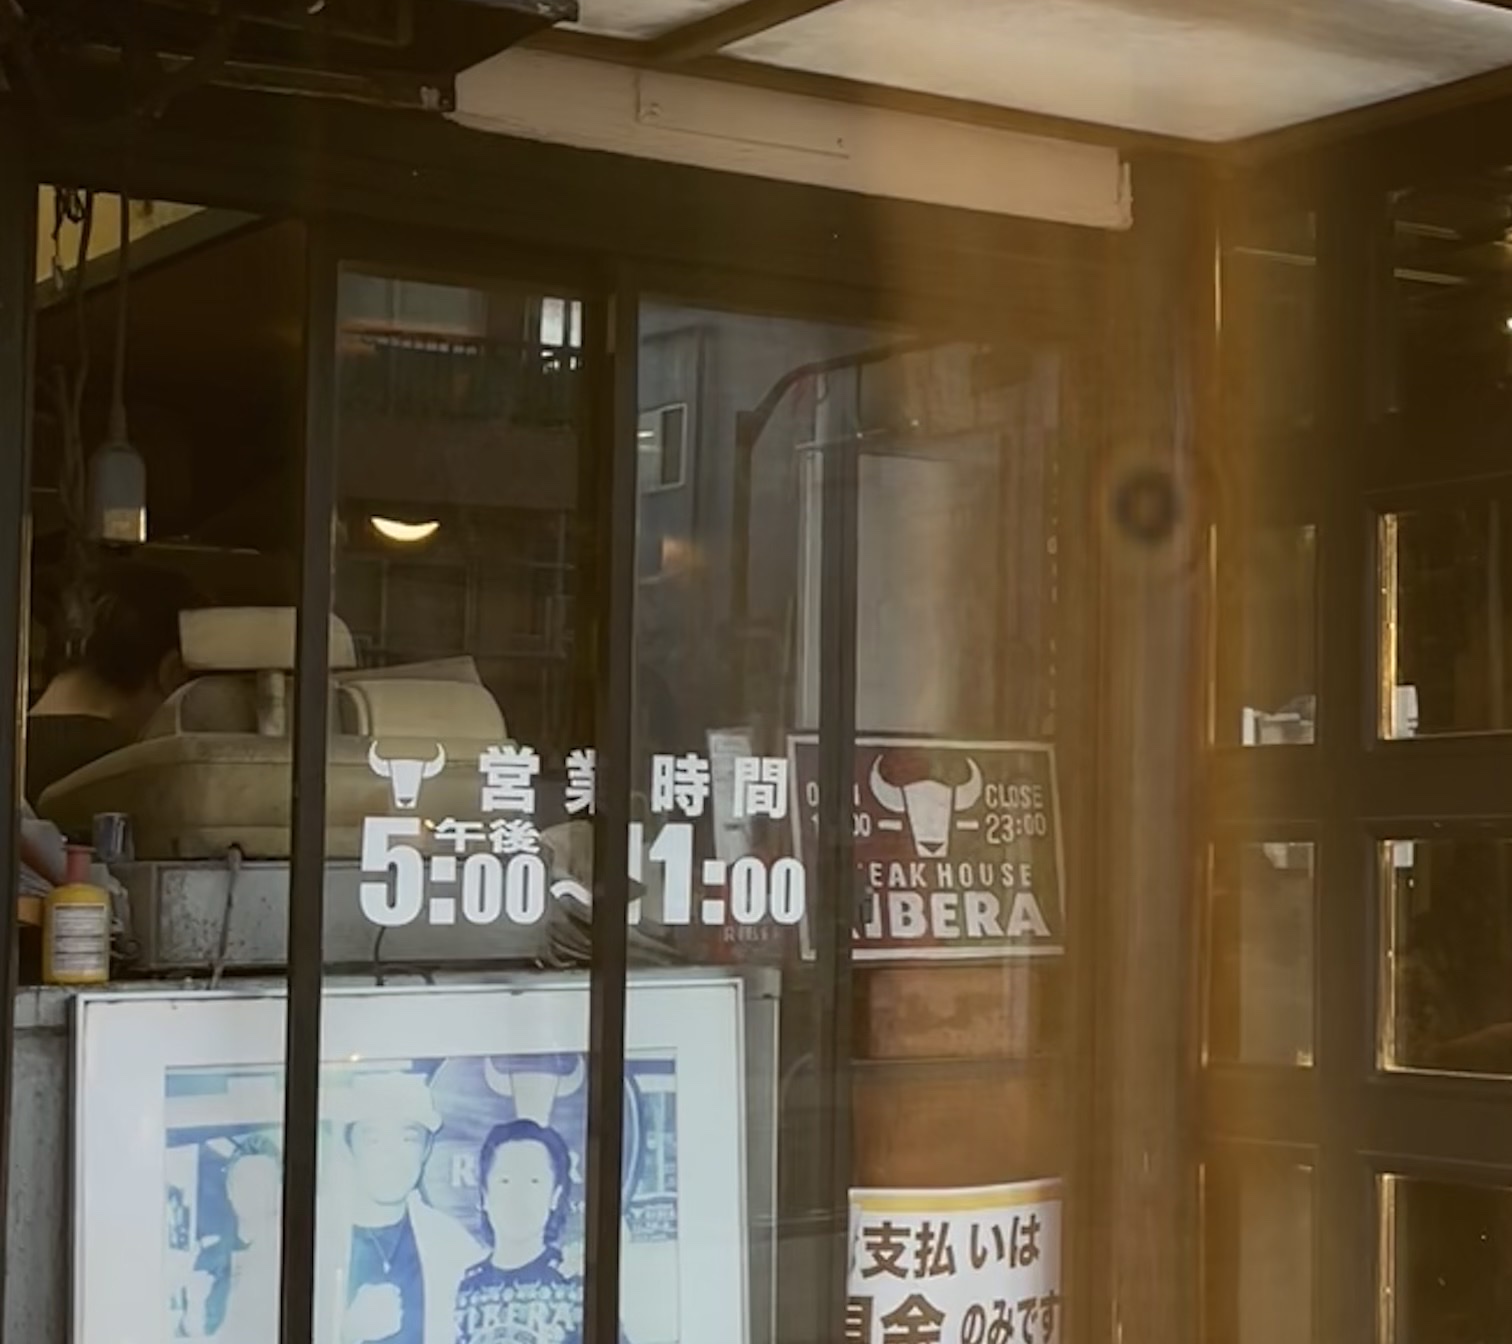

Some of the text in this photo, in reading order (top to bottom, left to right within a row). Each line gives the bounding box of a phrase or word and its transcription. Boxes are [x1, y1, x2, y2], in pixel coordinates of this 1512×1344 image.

[986, 783, 1044, 809] CLOSE
[434, 817, 541, 854] 午後
[985, 812, 1048, 844] 23:00
[857, 862, 1033, 888] EAK HOUSE
[852, 890, 1051, 940] IBERA
[850, 1213, 1042, 1280] 支払いは
